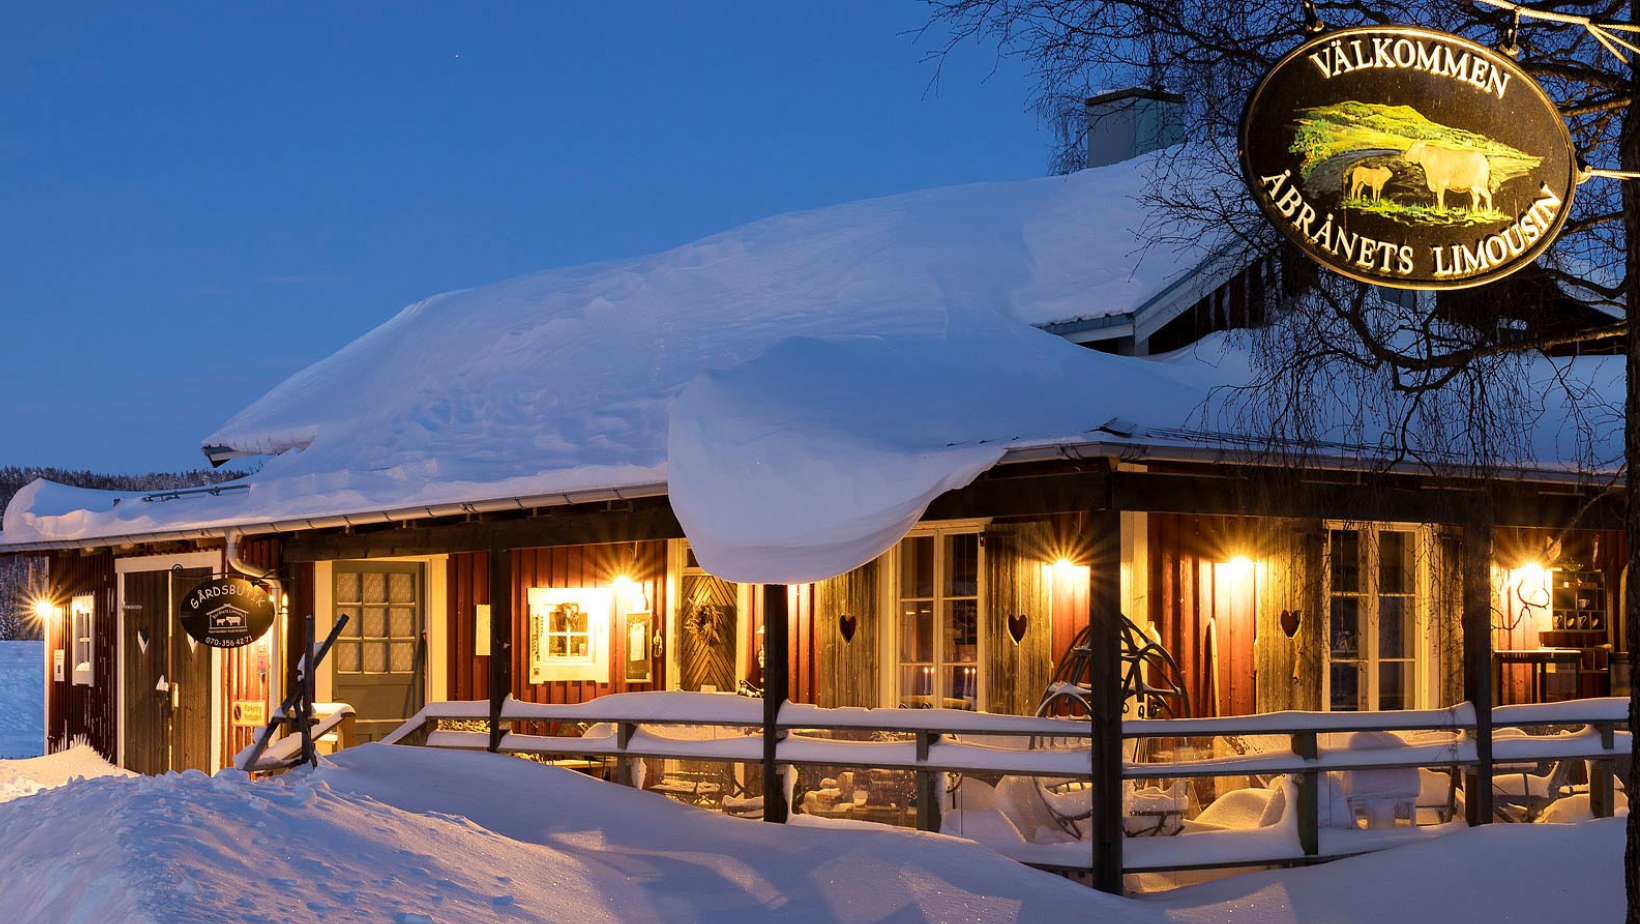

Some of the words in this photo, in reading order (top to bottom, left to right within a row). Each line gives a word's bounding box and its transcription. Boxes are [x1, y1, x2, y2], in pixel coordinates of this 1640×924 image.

[1309, 37, 1511, 100] VÄLKOMMEN
[1260, 169, 1415, 276] ÅBRÅNETS
[1433, 180, 1563, 278] LIMOUSIN
[190, 584, 265, 609] GÅRDSBUTIK
[205, 636, 235, 647] 070-356
